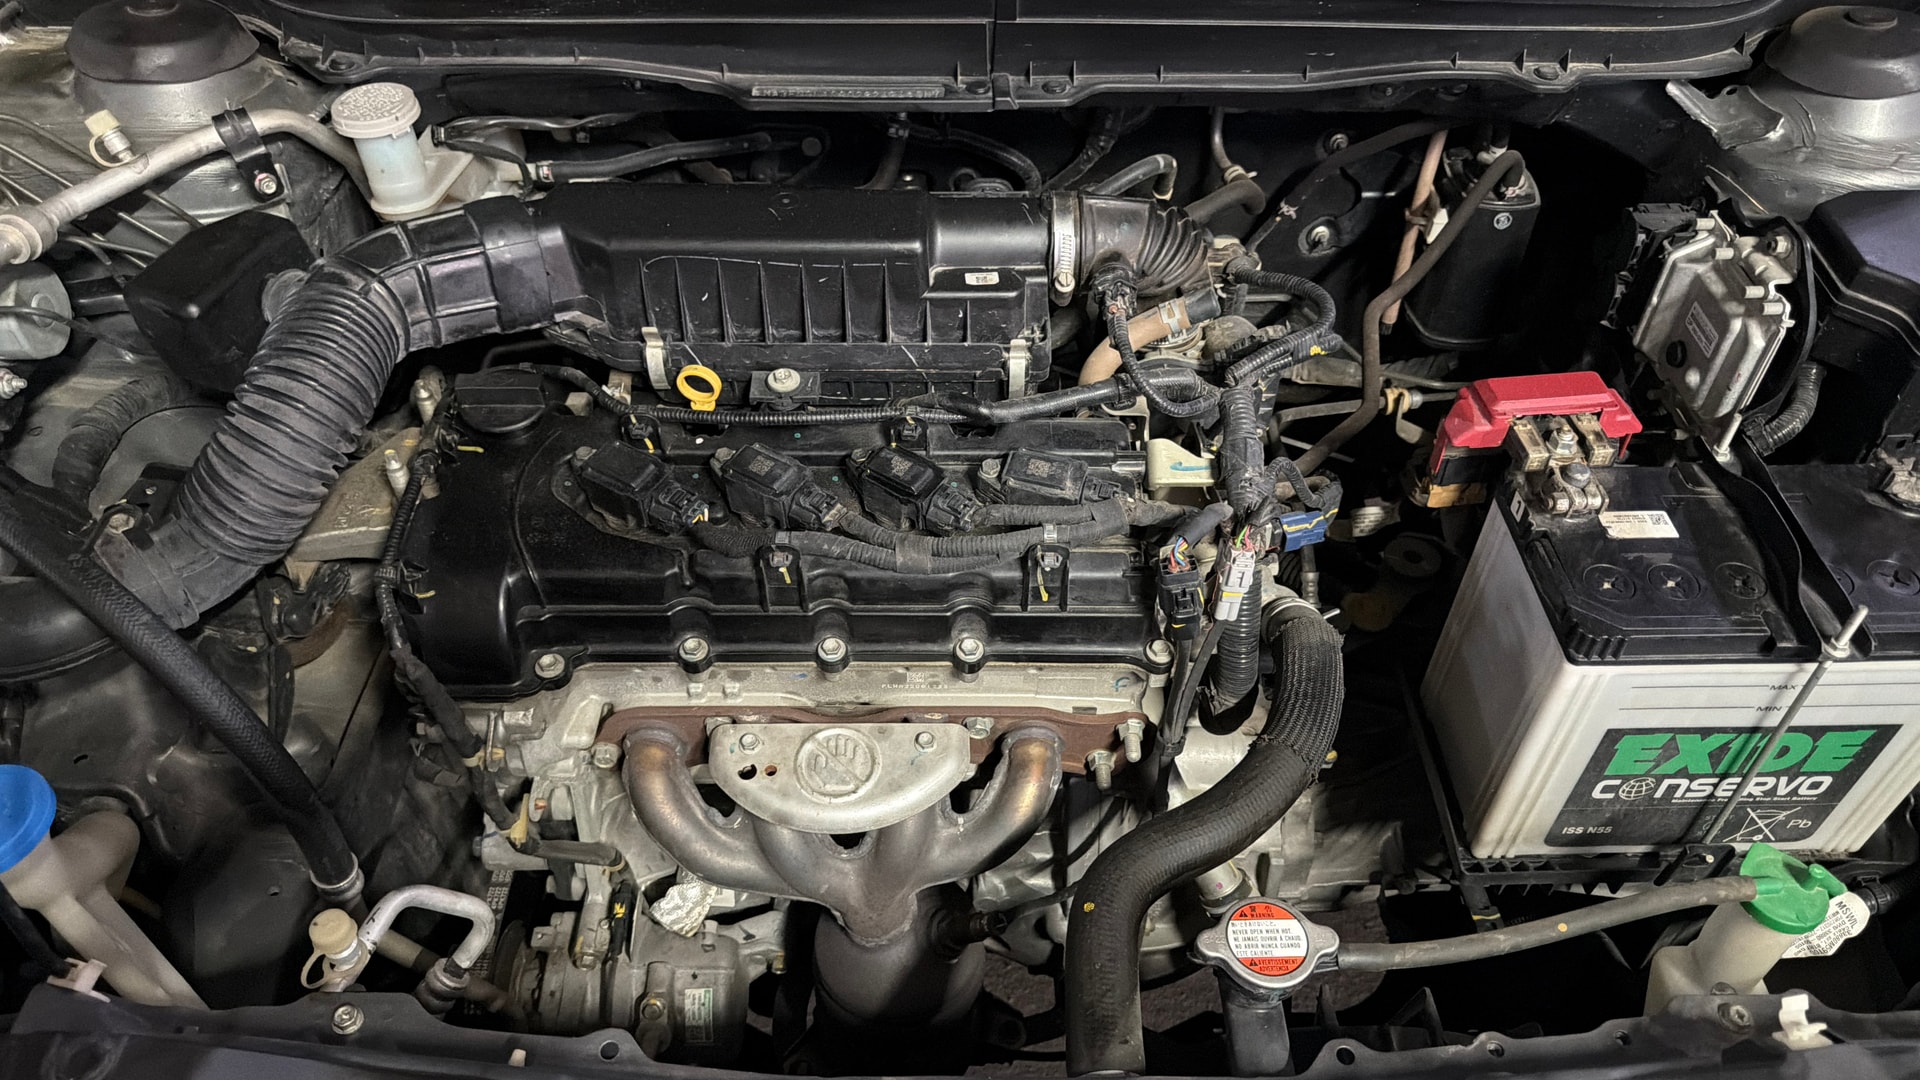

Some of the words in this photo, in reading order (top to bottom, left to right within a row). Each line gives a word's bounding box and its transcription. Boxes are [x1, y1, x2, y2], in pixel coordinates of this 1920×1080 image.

[1603, 729, 1877, 775] EXIDE
[1786, 819, 1813, 829] Pb
[1562, 826, 1584, 835] ISS
[1587, 826, 1614, 834] N55
